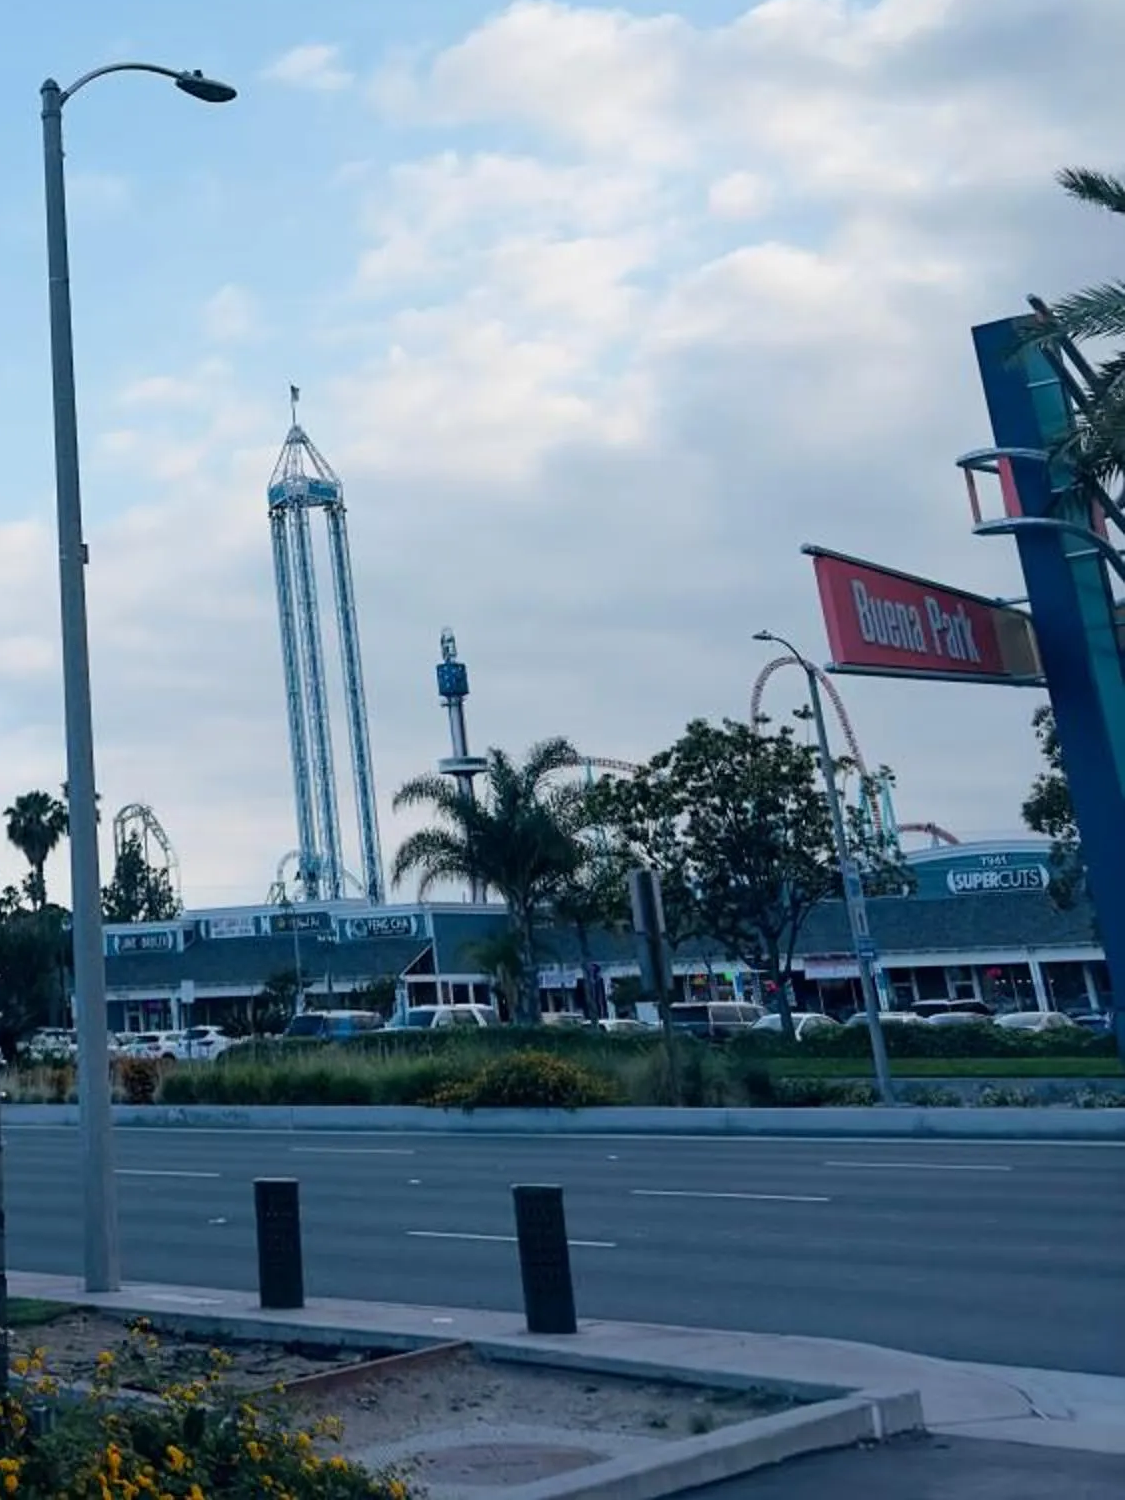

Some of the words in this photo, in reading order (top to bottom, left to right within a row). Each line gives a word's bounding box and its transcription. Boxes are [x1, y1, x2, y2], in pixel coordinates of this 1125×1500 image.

[851, 579, 928, 653] Buena
[924, 595, 981, 663] Park
[955, 869, 1040, 890] SUPERCUTS
